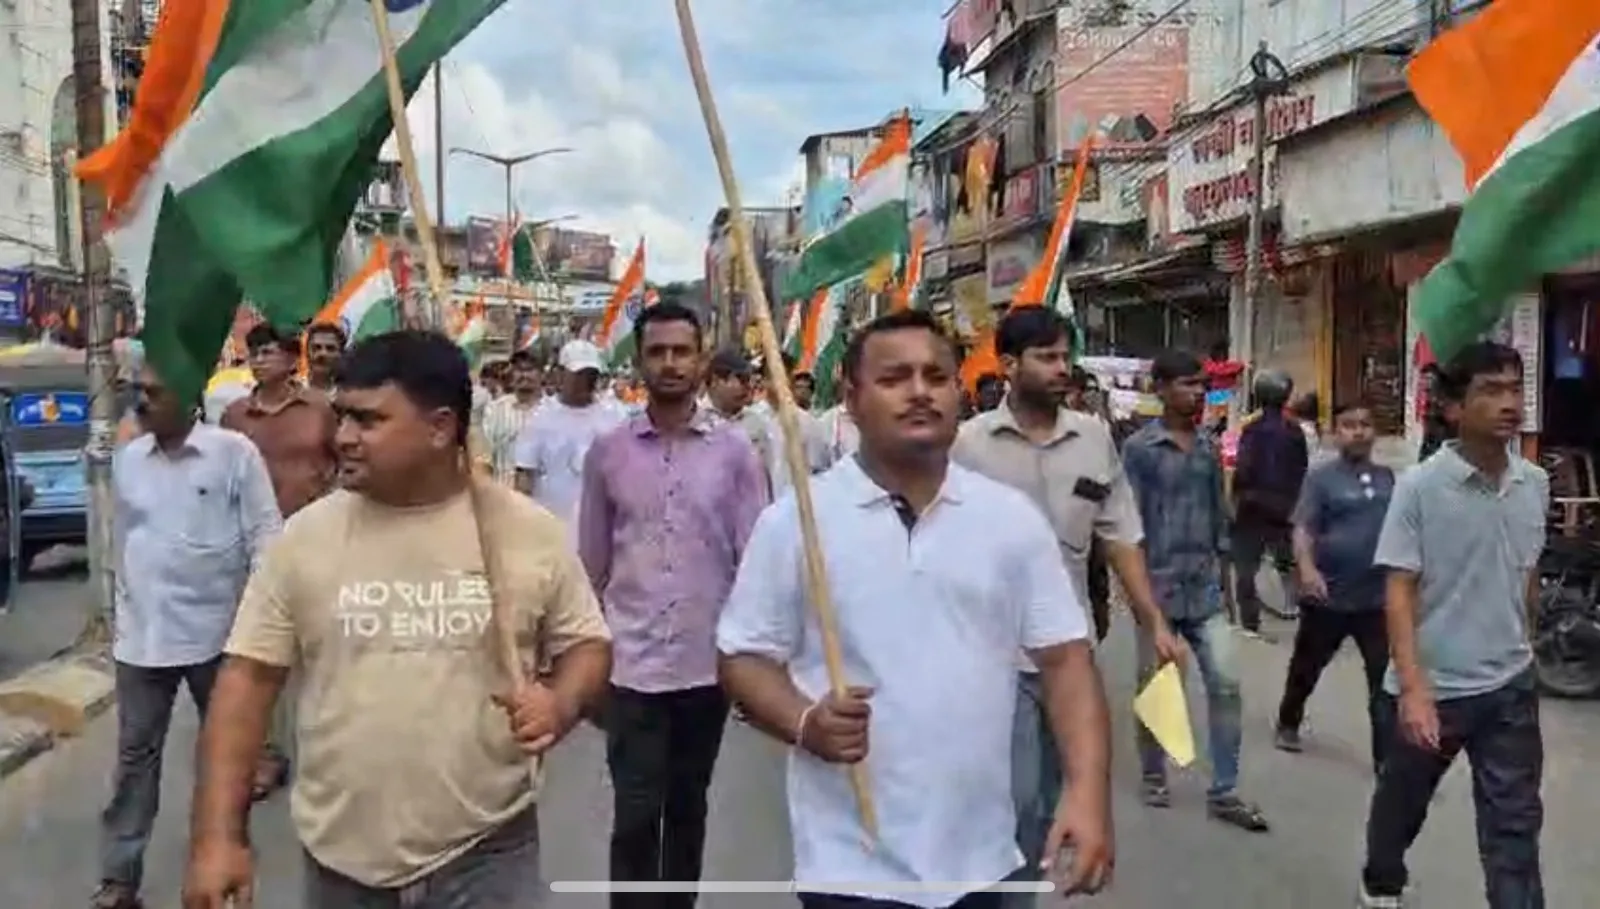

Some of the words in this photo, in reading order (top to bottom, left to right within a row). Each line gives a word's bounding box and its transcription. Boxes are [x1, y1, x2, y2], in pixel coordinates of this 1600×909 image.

[338, 581, 389, 608] NO
[336, 612, 382, 637] TO
[391, 609, 493, 638] ENJOY
